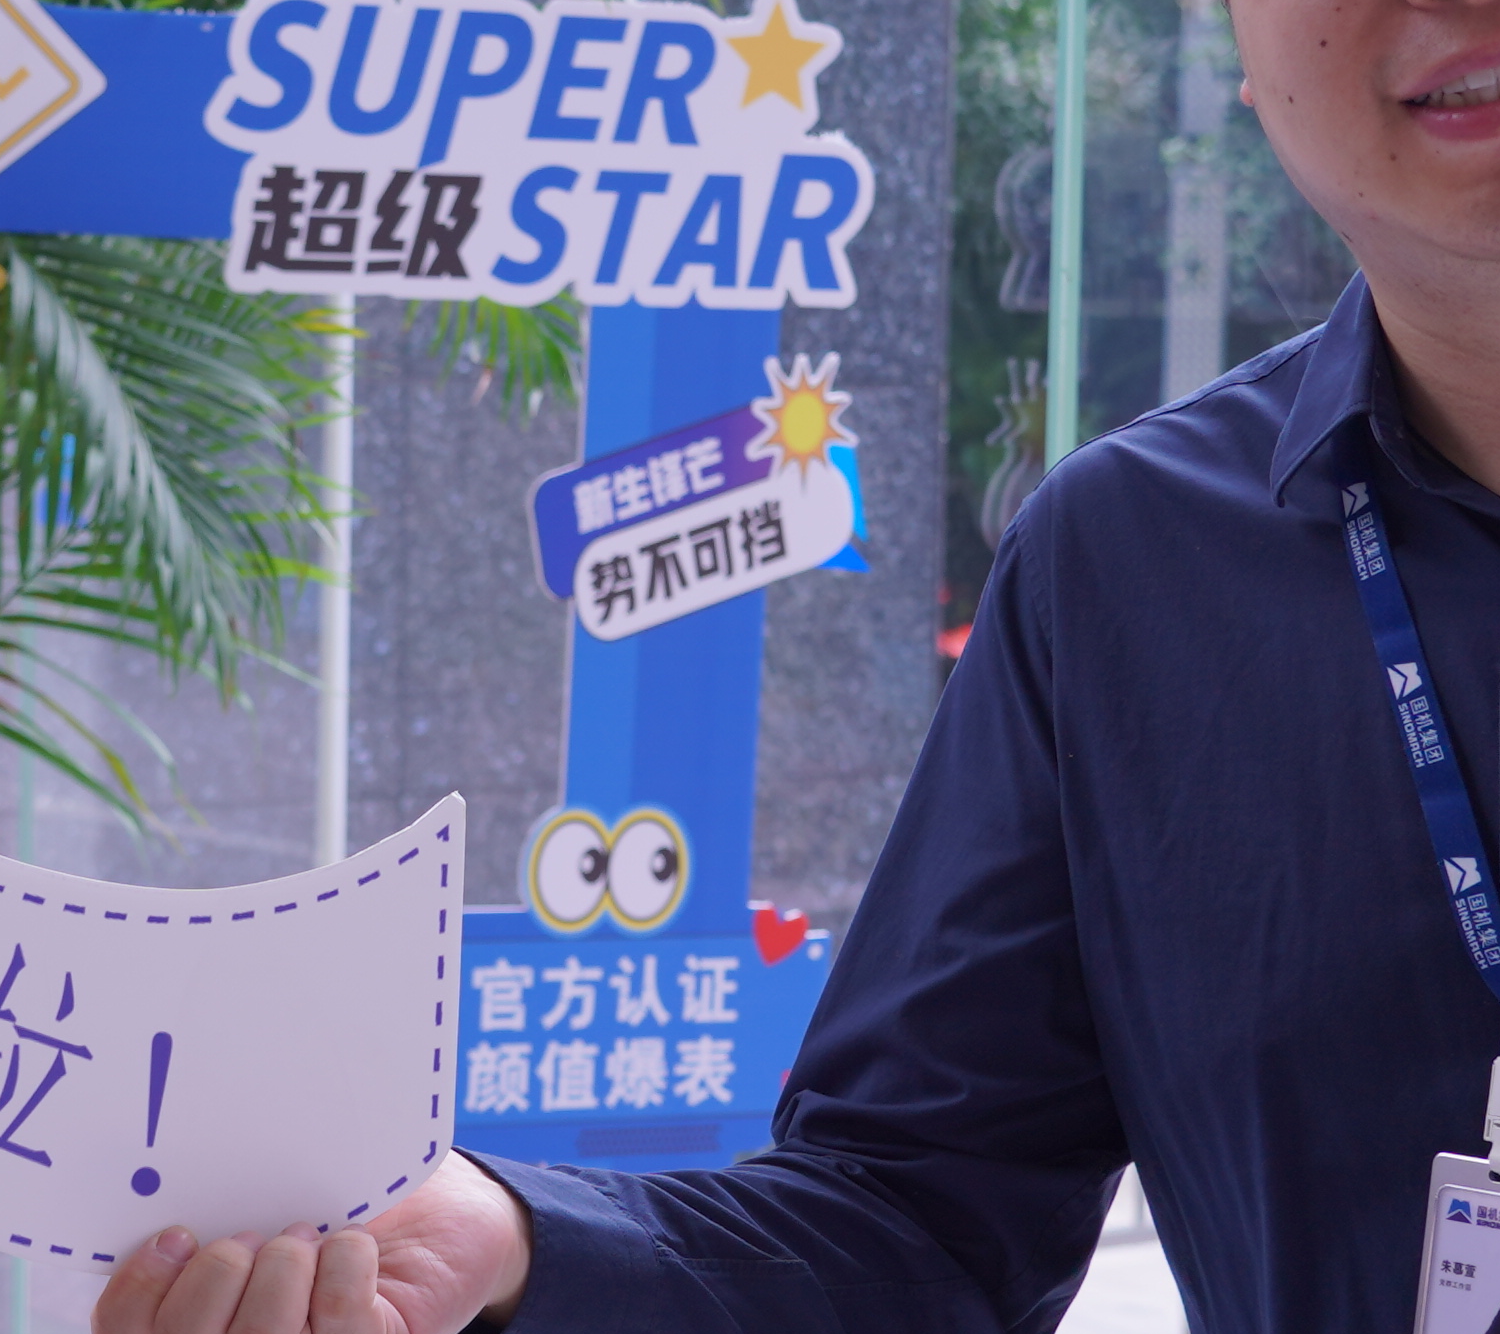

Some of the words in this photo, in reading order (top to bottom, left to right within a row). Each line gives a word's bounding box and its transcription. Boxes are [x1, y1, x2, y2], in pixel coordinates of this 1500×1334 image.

[244, 163, 483, 280] 超级
[491, 153, 862, 291] STAR
[590, 500, 787, 627] 势不可挡
[1345, 520, 1370, 582] SINOMACH
[1356, 510, 1386, 576] 国机集团
[1397, 702, 1425, 770] SINOMACH
[1408, 695, 1444, 765] 国机集团
[1454, 897, 1489, 971] SINOMACH
[471, 954, 740, 1033] 官方认证
[463, 1035, 736, 1115] 颜值爆表
